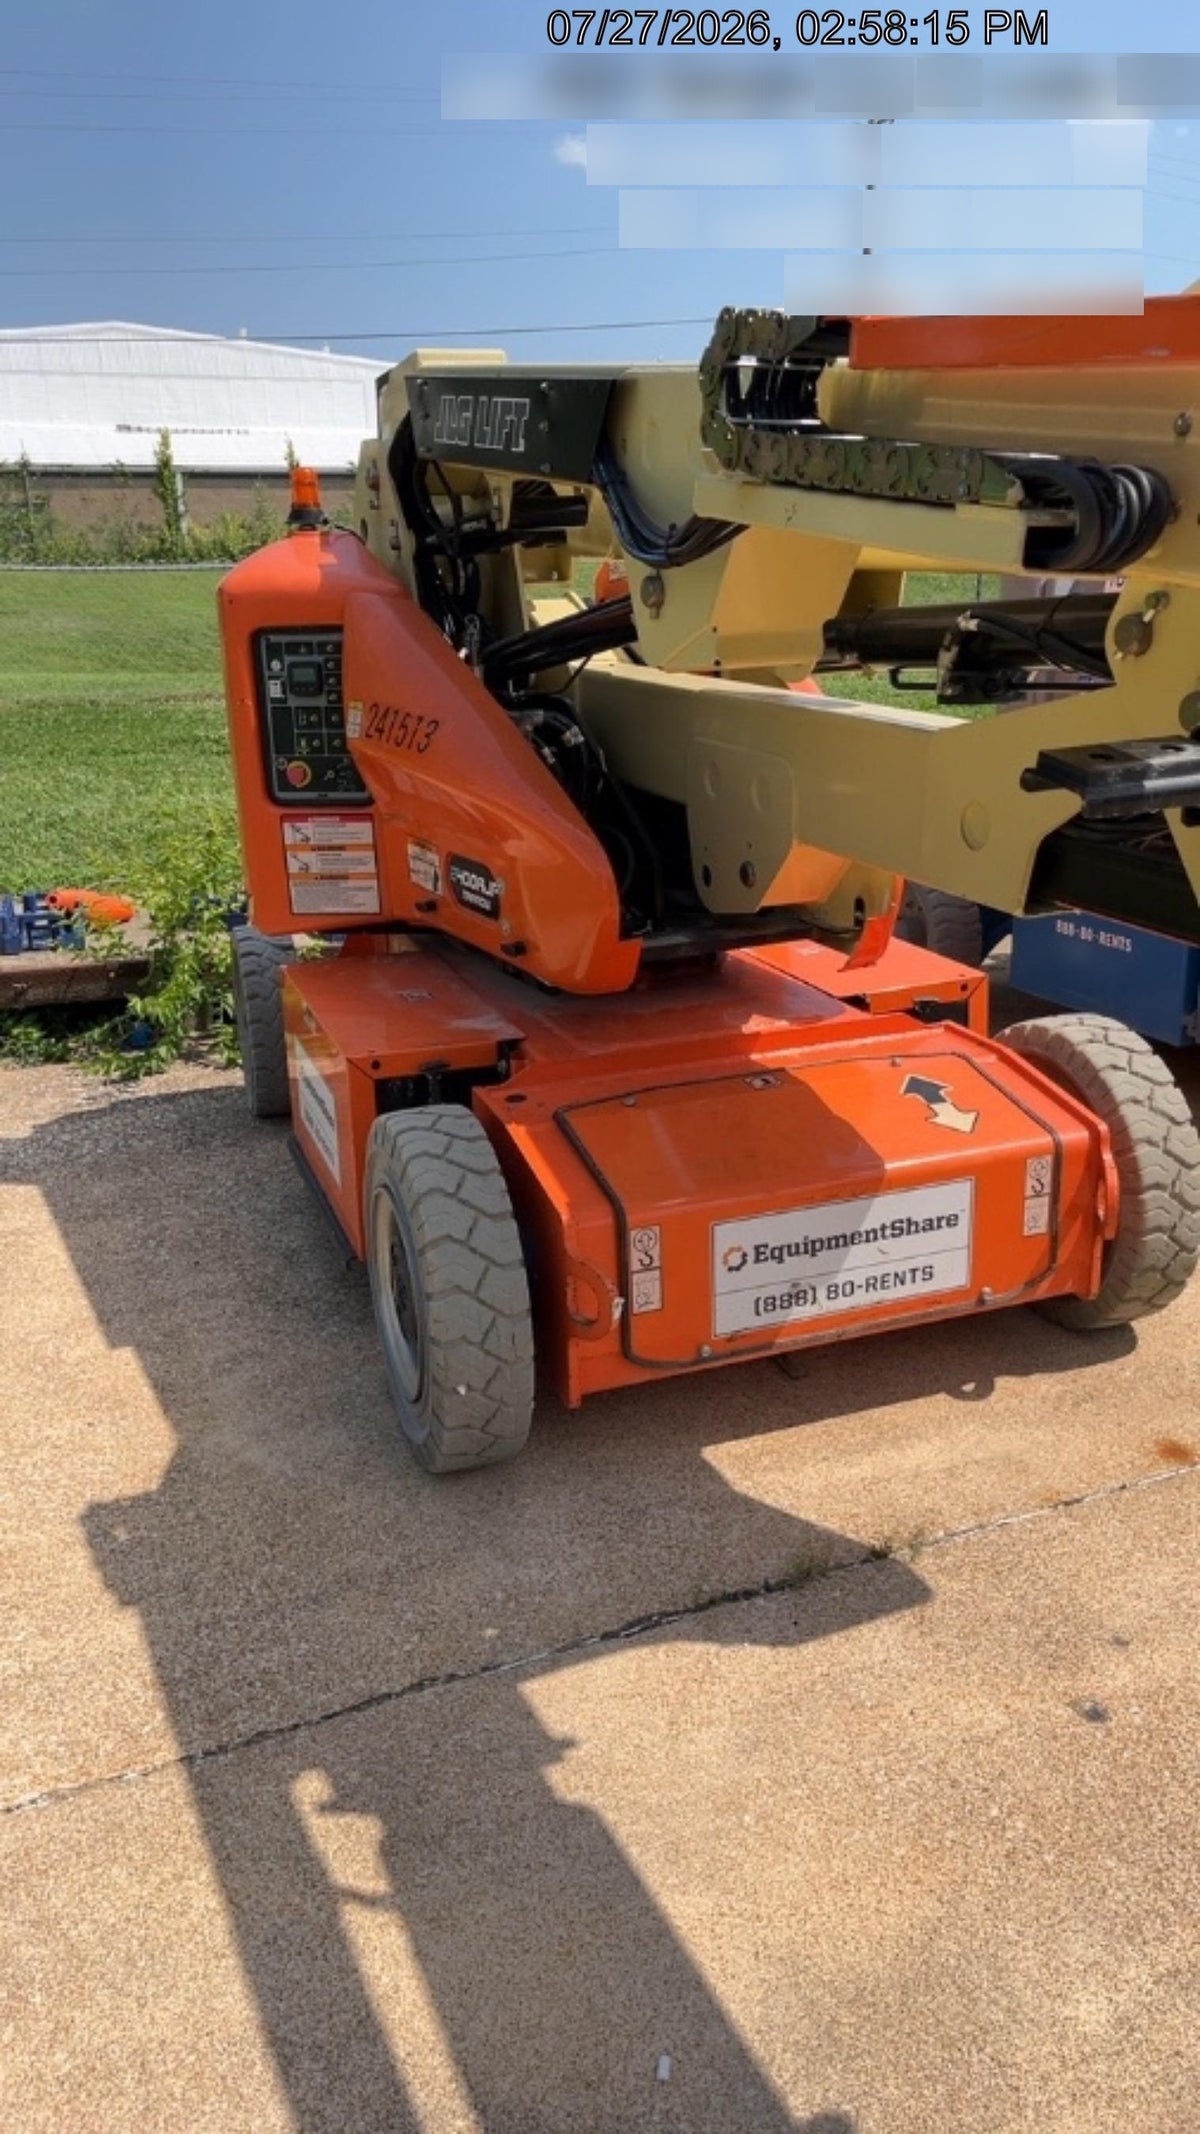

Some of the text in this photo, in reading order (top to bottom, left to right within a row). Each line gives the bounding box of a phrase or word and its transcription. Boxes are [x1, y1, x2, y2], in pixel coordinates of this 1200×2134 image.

[474, 395, 530, 452] LIFT
[365, 703, 440, 754] 241513
[752, 1211, 960, 1264] EquipmentShare
[754, 1264, 934, 1317] (888) 80-RENTS
